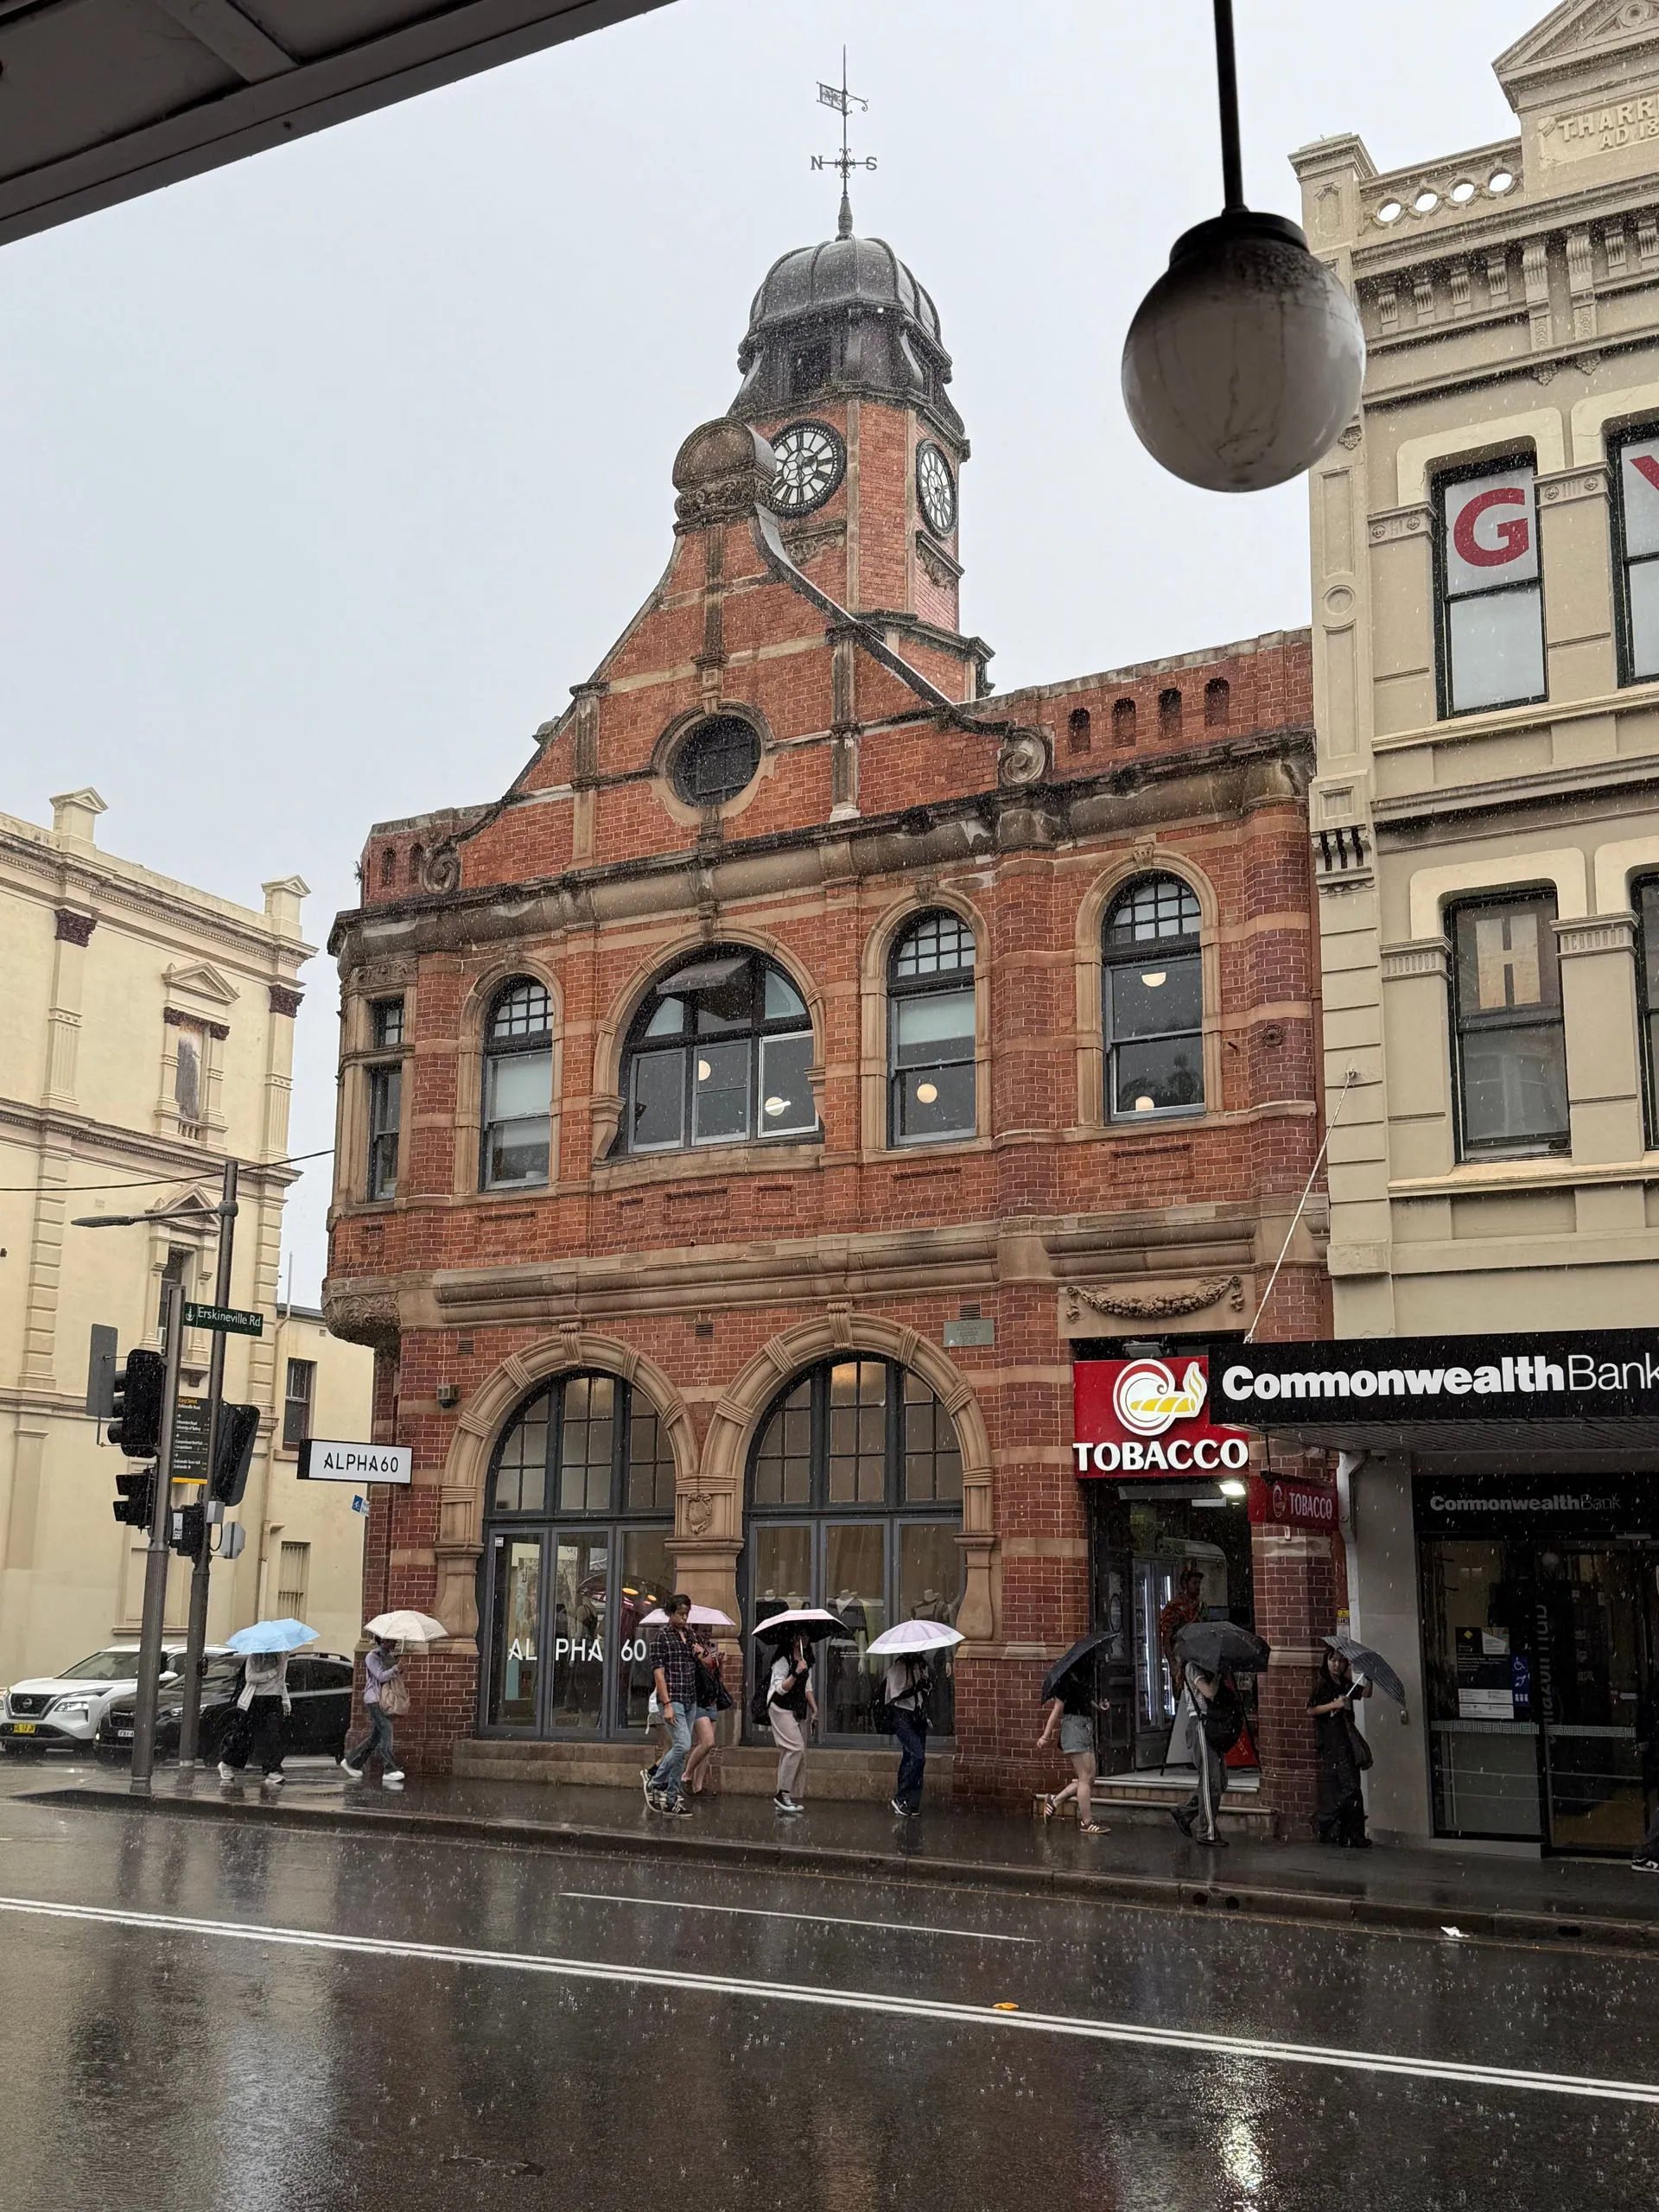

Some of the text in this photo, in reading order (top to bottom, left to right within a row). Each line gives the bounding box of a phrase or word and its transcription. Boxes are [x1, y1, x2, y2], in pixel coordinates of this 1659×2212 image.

[1599, 128, 1629, 151] AD
[810, 156, 878, 170] N S
[1453, 487, 1529, 567] G
[1476, 913, 1541, 1009] H
[197, 1306, 261, 1327] Erskineville Rd
[323, 1452, 399, 1473] ALPHA60
[1072, 1439, 1249, 1471] TOBACCO
[1289, 1492, 1332, 1520] TOBACCO
[620, 1638, 647, 1662] 60
